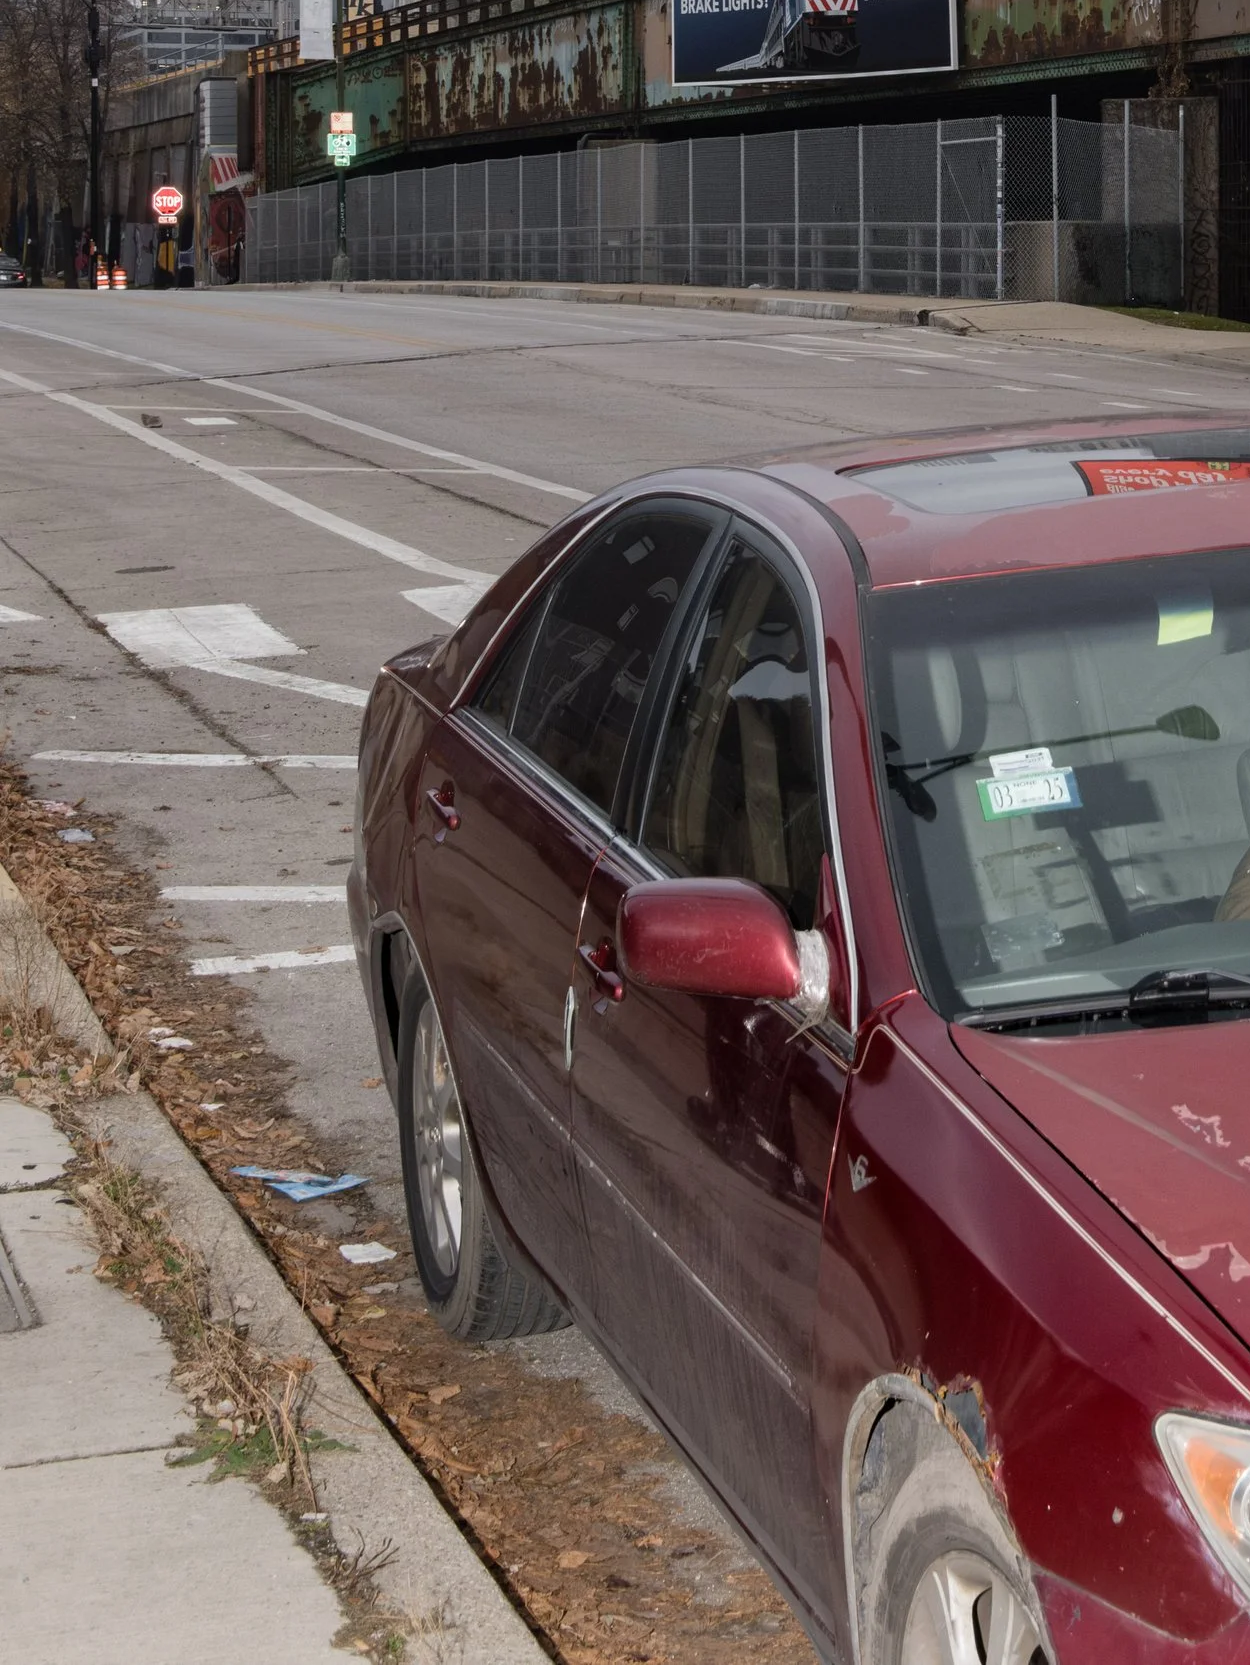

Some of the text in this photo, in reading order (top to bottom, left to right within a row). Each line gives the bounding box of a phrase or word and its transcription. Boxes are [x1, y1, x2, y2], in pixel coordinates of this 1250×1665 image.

[156, 196, 180, 207] STOP
[993, 777, 1063, 808] 03 25
